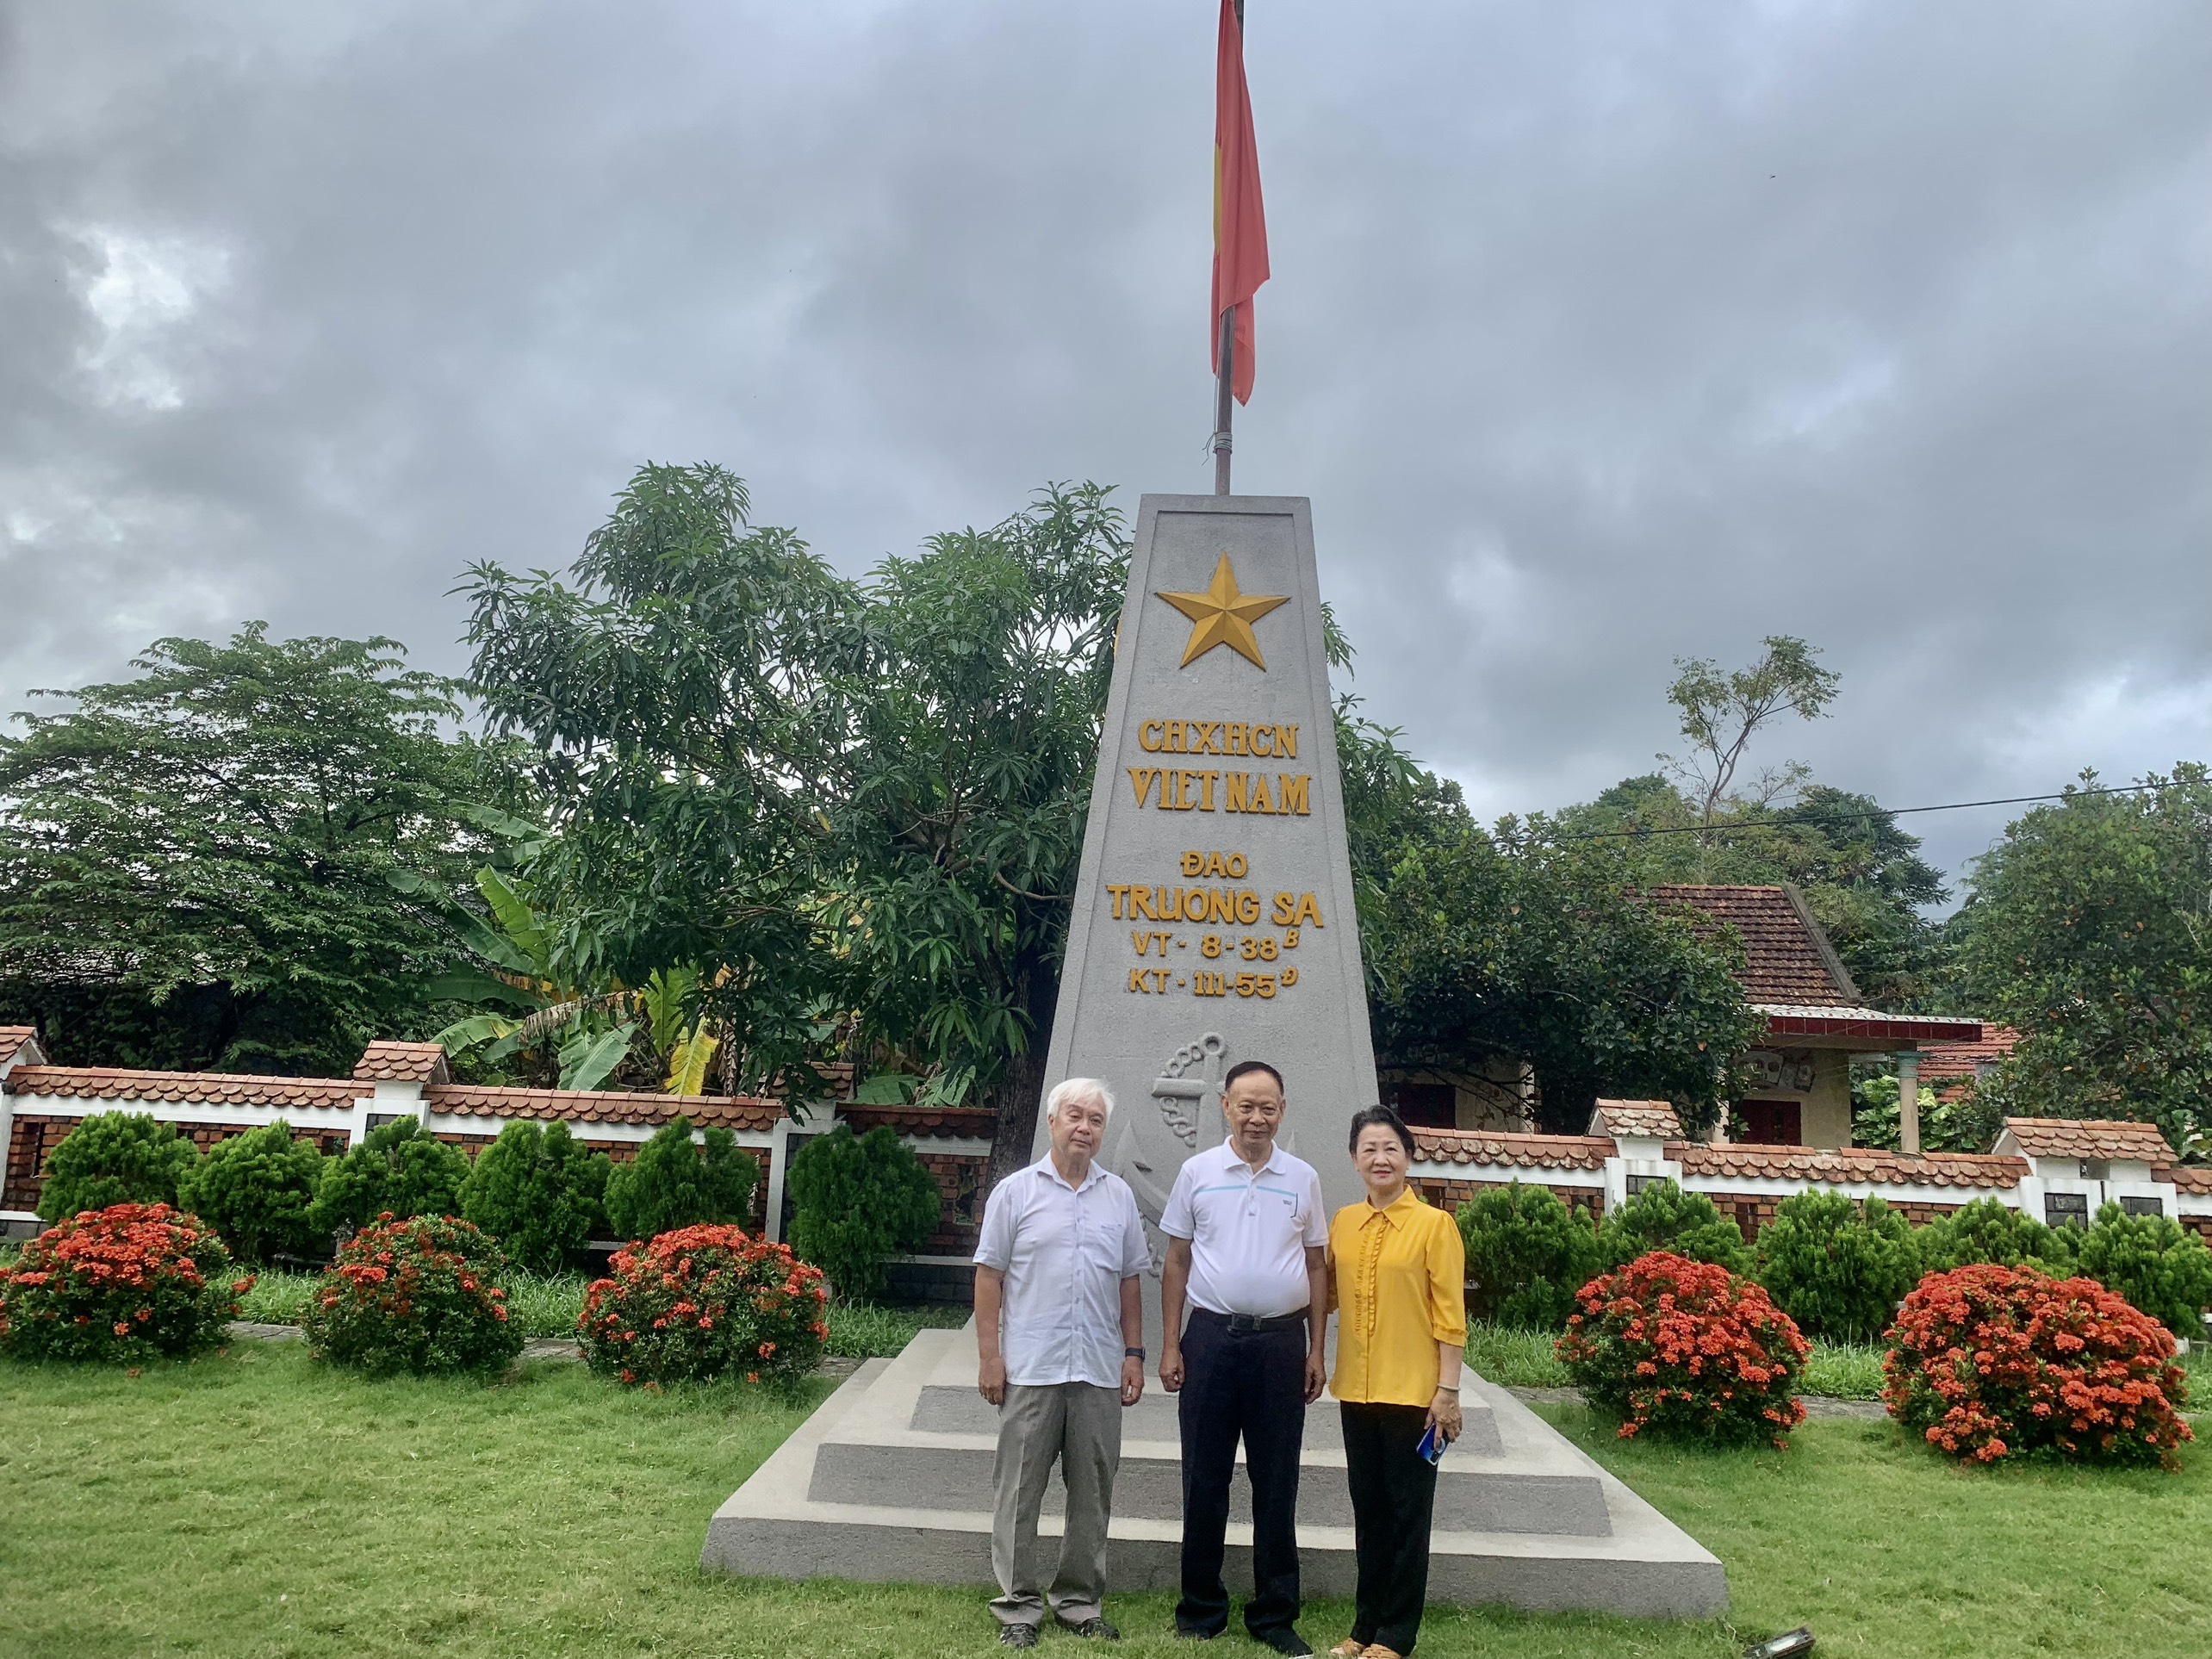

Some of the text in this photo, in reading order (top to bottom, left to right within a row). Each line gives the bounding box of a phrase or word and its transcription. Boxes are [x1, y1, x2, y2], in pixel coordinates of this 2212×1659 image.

[1139, 718, 1298, 759] CHXHCN
[1128, 767, 1310, 815] VIET NAM
[1180, 850, 1247, 878] ĐAO
[1107, 885, 1323, 928] TRUONG SA
